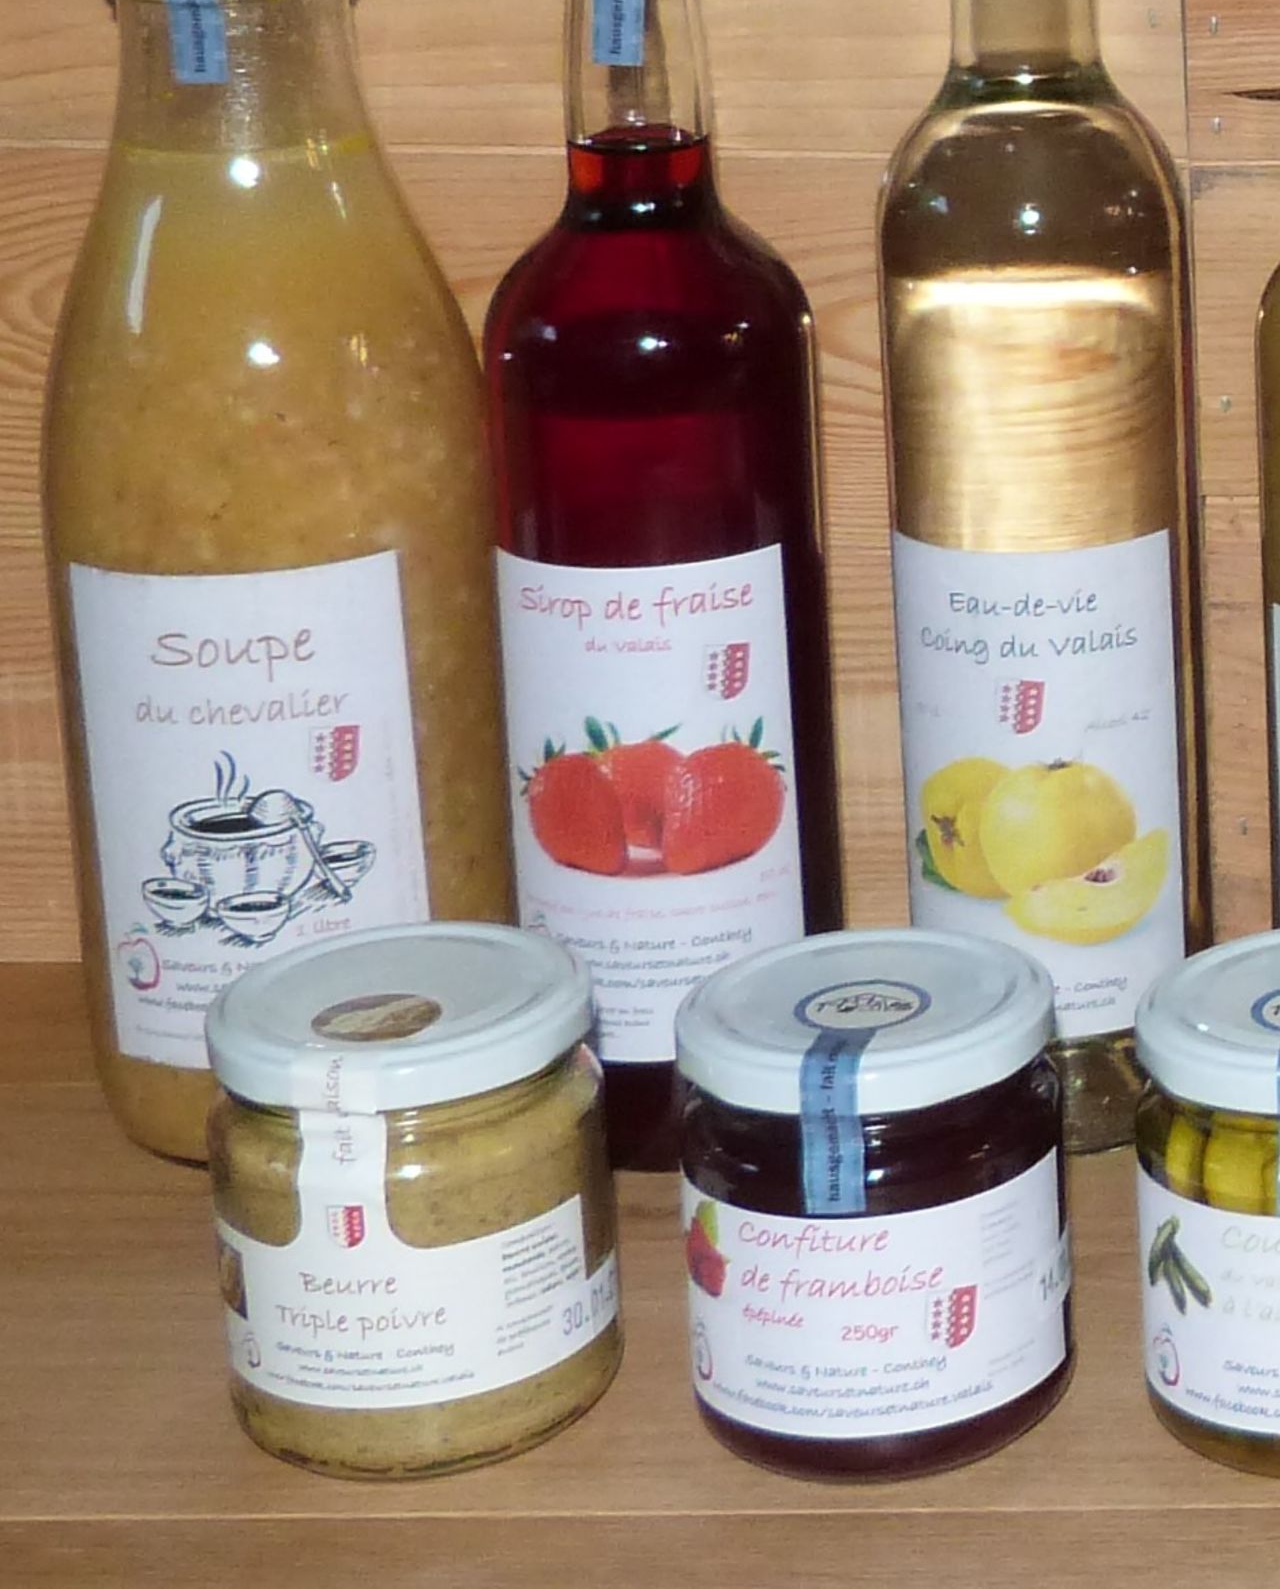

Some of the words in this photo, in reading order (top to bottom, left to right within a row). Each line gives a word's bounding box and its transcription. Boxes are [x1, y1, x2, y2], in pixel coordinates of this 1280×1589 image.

[520, 584, 593, 632] Sirop
[605, 592, 642, 621] de
[653, 583, 753, 626] fraise
[949, 590, 1099, 618] Eau-de-vie
[150, 628, 314, 681] Soupe
[585, 638, 607, 653] du
[611, 637, 672, 653] valais
[920, 627, 989, 663] Coing
[1000, 635, 1038, 658] du
[136, 696, 177, 722] du
[189, 689, 349, 725] chevalier
[738, 1221, 890, 1259] Confiture
[299, 1271, 398, 1295] Beurre
[742, 1264, 770, 1291] de
[780, 1266, 944, 1301] framboise
[275, 1305, 349, 1337] Triple
[361, 1305, 448, 1338] poivre
[841, 1324, 899, 1343] 250gr
